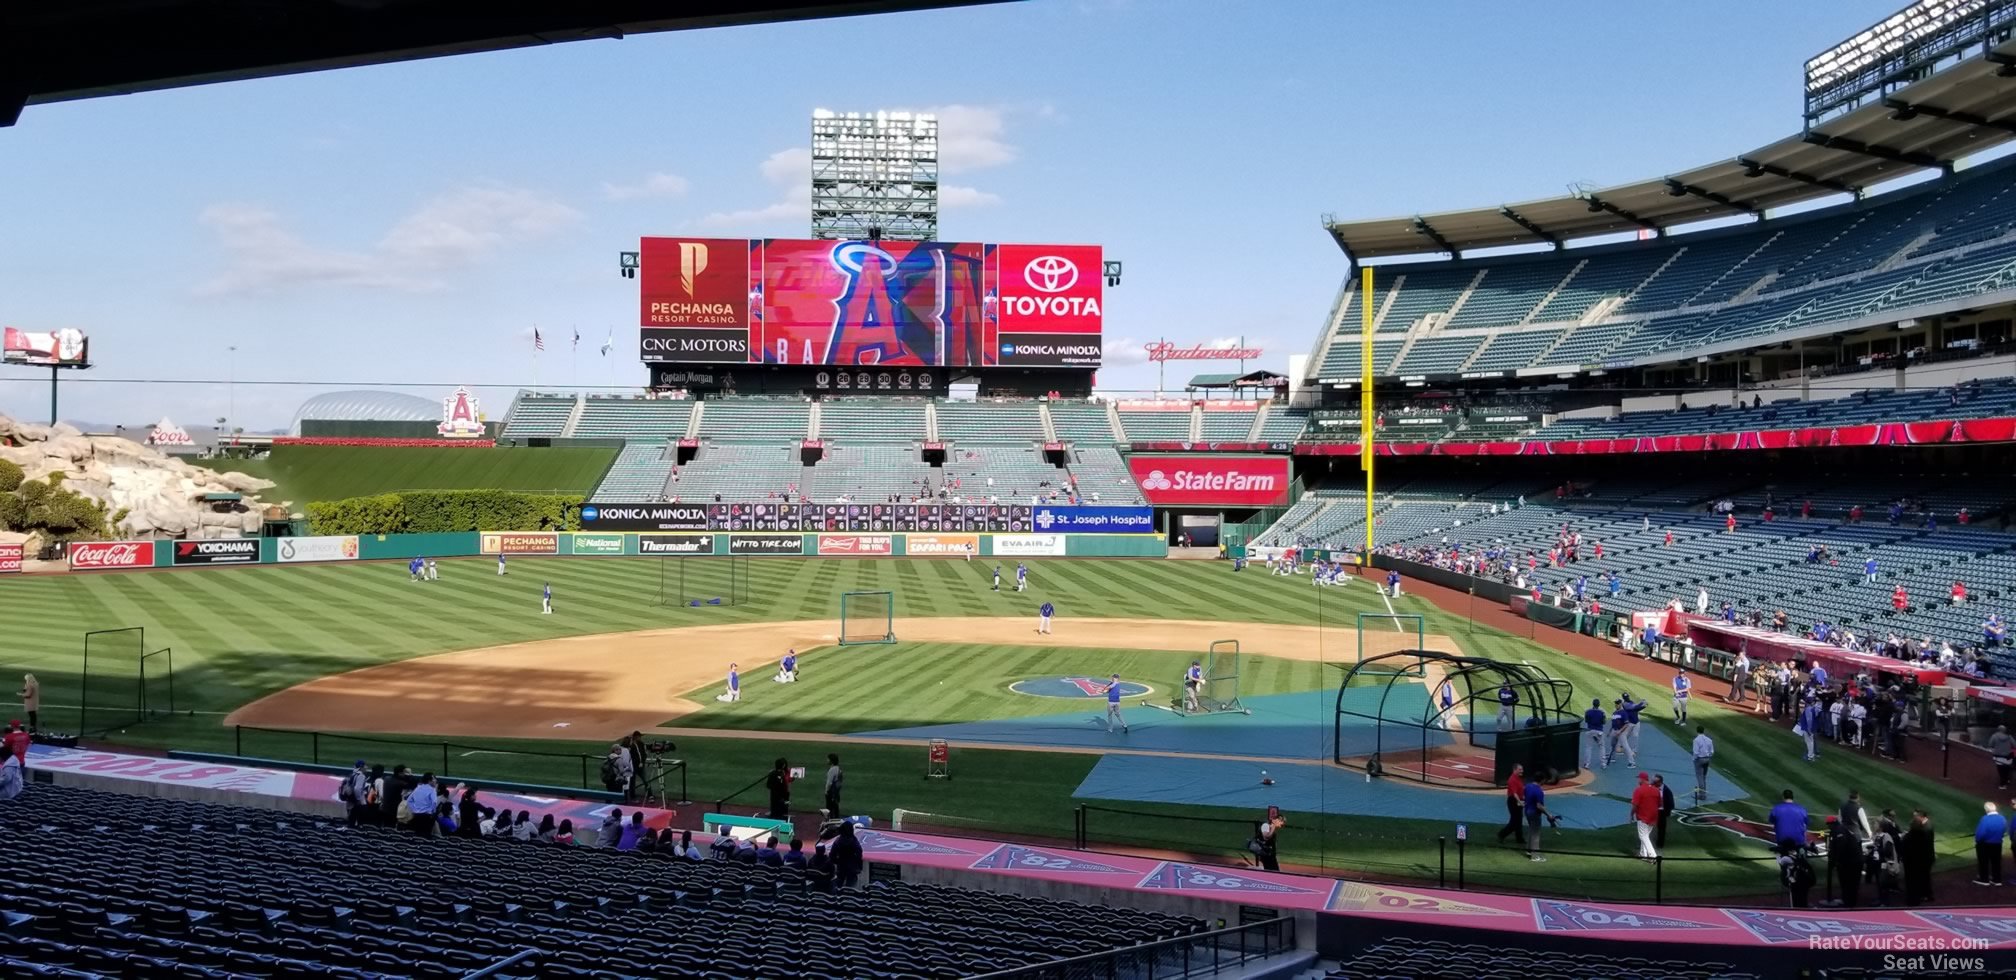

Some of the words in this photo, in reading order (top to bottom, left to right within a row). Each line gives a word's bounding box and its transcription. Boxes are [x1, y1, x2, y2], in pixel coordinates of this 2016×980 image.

[651, 303, 733, 314] PECHANGA
[1002, 296, 1100, 316] TOYOTA
[652, 315, 690, 323] RESORT
[642, 338, 677, 351] CNC
[680, 339, 746, 352] MOTORS
[1015, 345, 1055, 355] KONICA
[1056, 345, 1100, 355] MINOLTA
[1145, 342, 1262, 361] Budweiser
[661, 371, 687, 384] Captain
[685, 371, 713, 384] Morgan
[839, 374, 849, 382] 26
[880, 375, 889, 383] 30
[900, 375, 909, 383] 42
[921, 376, 930, 384] 50
[600, 508, 649, 519] KONICA
[651, 508, 706, 519] MINOLTA
[1057, 515, 1070, 524] St.
[1073, 515, 1108, 526] Joseph
[1111, 515, 1150, 526] Hospital
[504, 537, 555, 545] PECHANGA
[586, 538, 621, 547] National
[642, 540, 700, 551] Thermador
[732, 539, 758, 548] NITTO
[197, 542, 253, 553] YOKOHAMA
[910, 544, 946, 552] SAFARI
[73, 545, 140, 566] Coca-Cola
[35, 755, 237, 781] 2018
[875, 837, 919, 851] '79
[1024, 848, 1072, 870] '82
[1189, 871, 1242, 888] '86
[1375, 891, 1440, 912] '02
[1576, 908, 1644, 927] '04
[1776, 917, 1852, 933] '05
